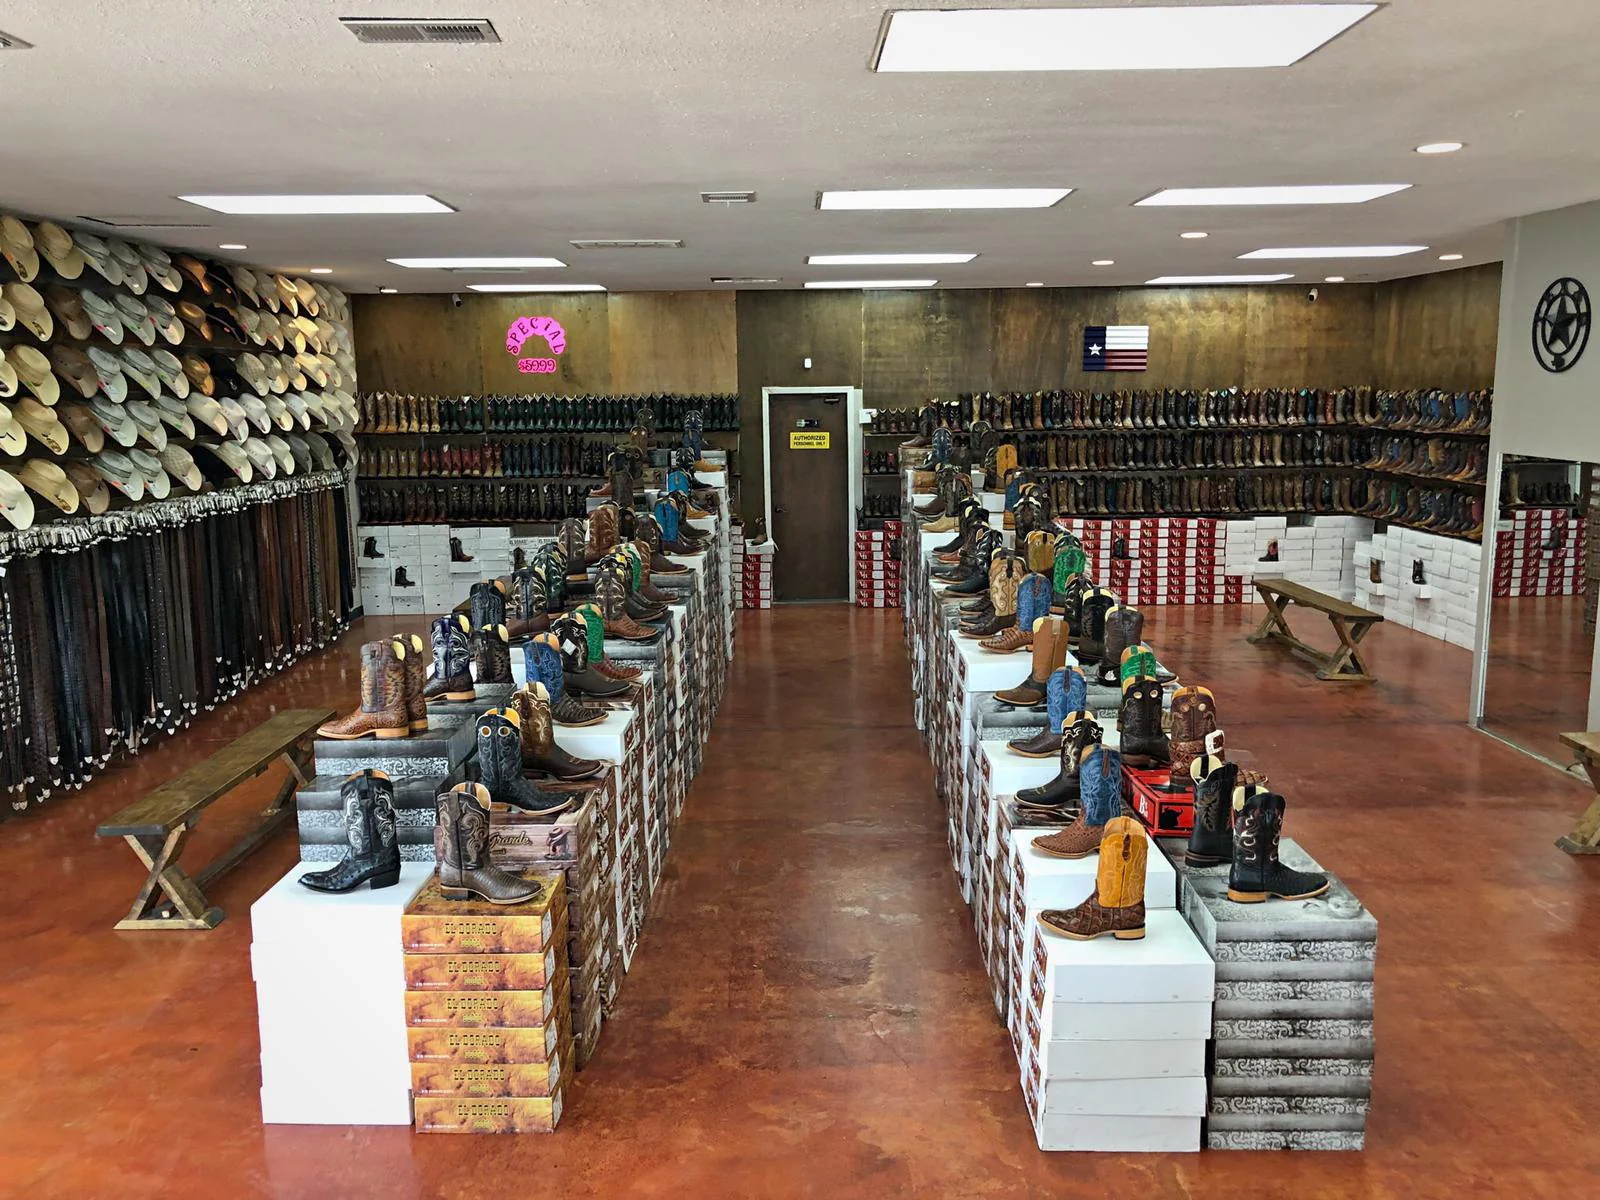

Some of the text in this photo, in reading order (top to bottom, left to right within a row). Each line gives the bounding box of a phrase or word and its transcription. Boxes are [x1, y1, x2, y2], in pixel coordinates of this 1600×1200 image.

[445, 922, 496, 934] EL DORADO
[448, 961, 500, 973] EL DORADO
[447, 998, 498, 1010] EL DORADO
[449, 1034, 500, 1046] EL DORADO
[453, 1069, 505, 1081] EL DORADO
[457, 1104, 509, 1116] EL DORADO
